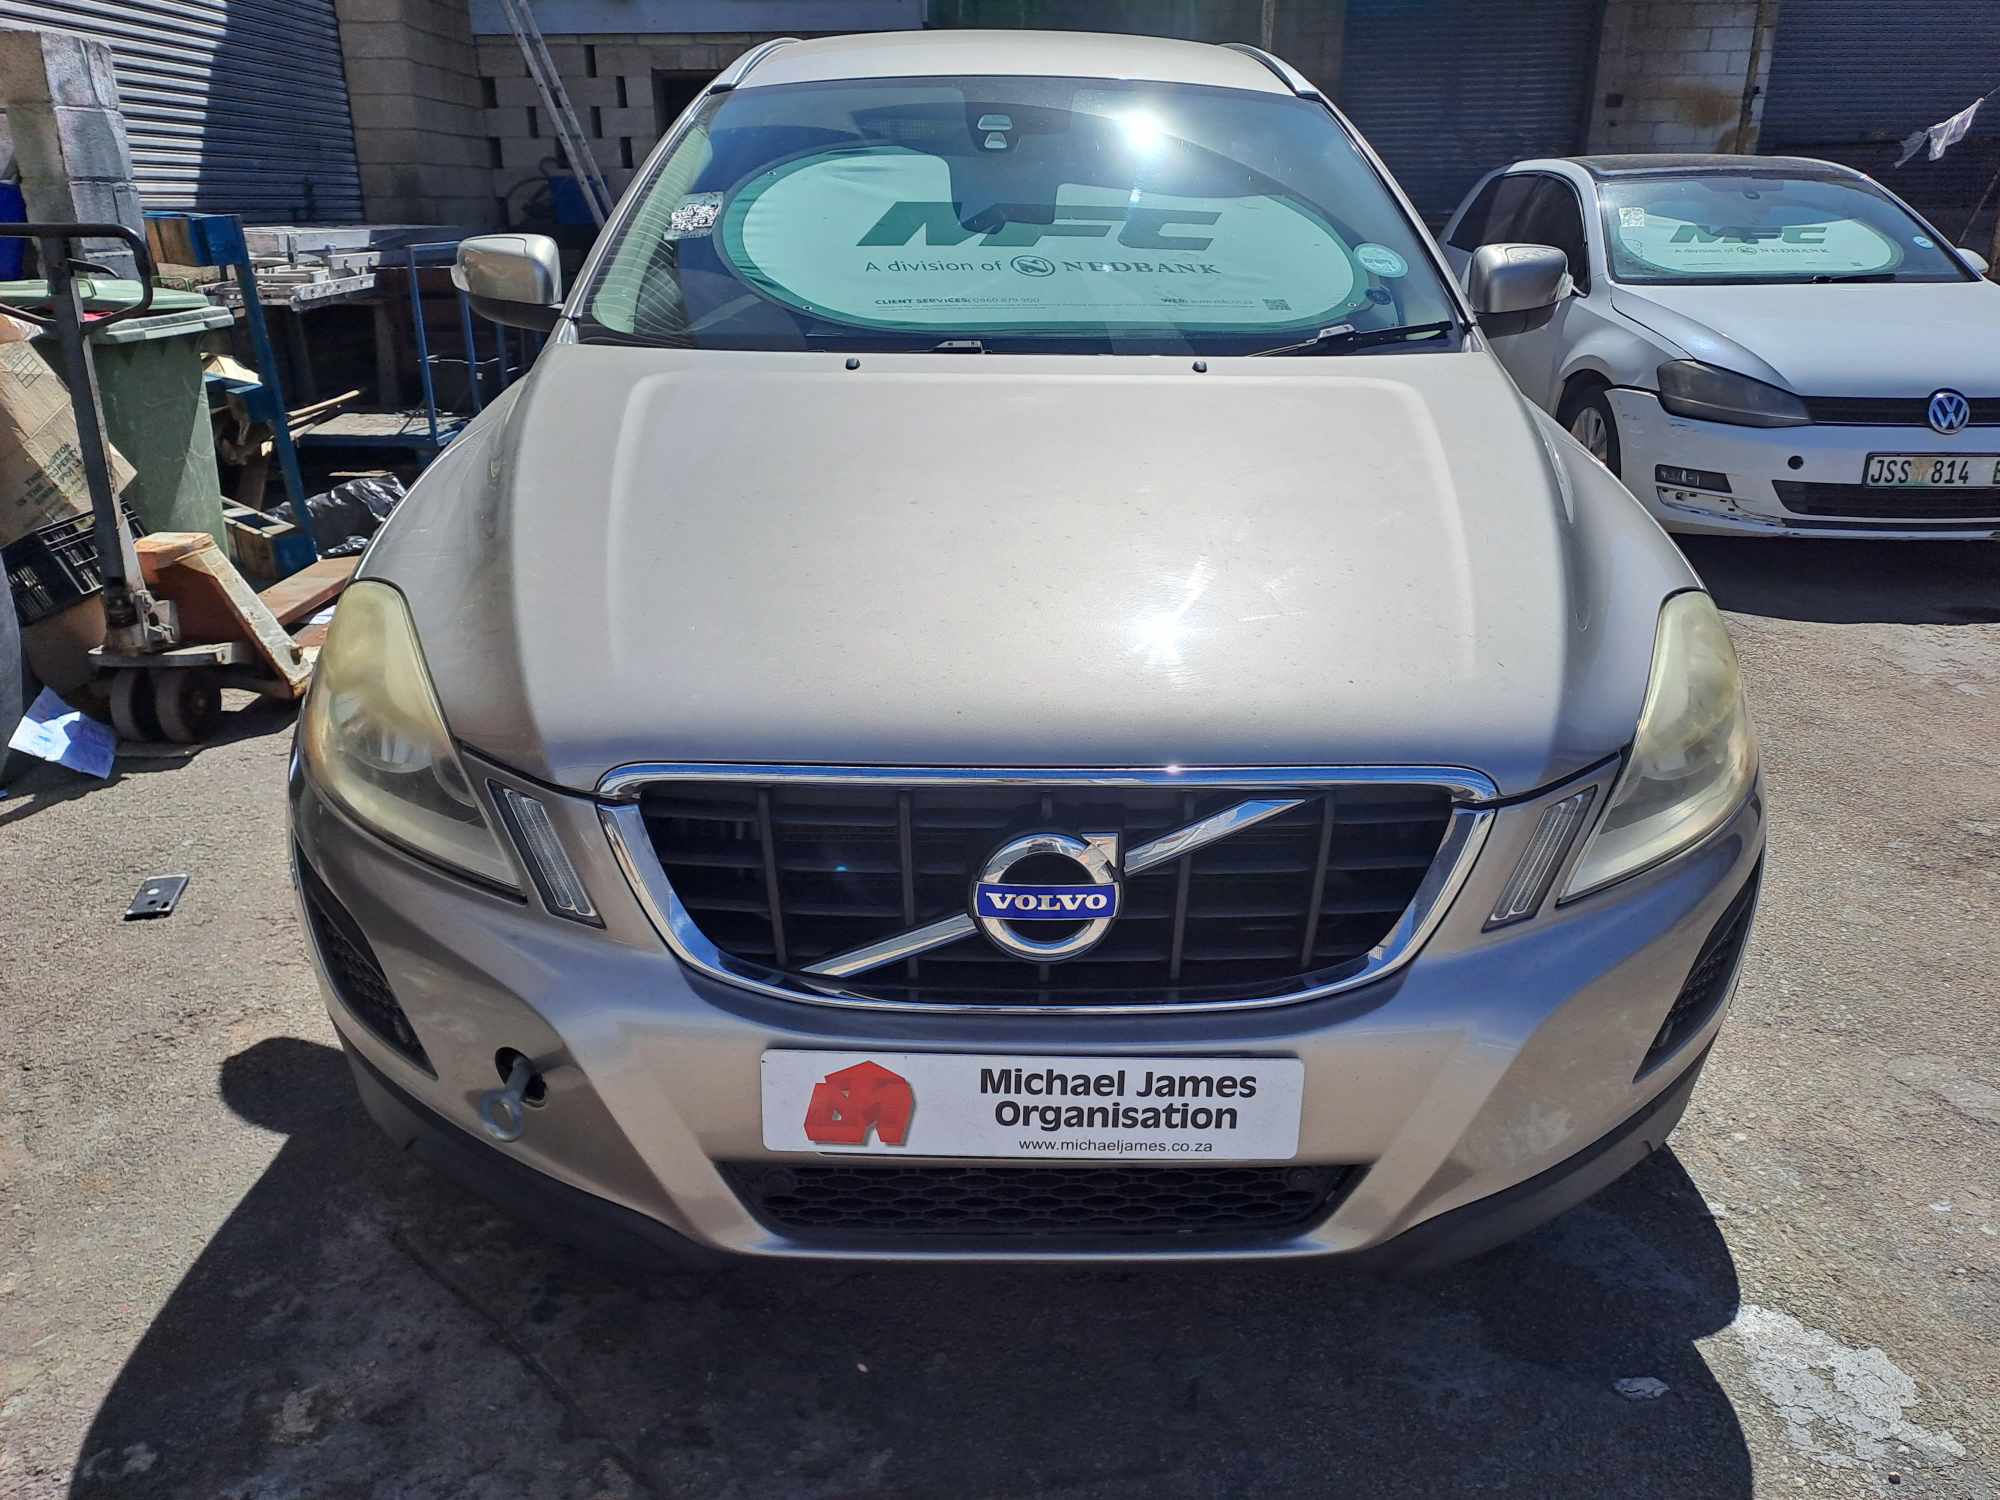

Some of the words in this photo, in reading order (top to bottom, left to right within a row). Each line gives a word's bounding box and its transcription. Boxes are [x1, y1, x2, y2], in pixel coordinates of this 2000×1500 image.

[856, 201, 1223, 251] MFC
[865, 261, 881, 272] A
[887, 260, 974, 273] division
[981, 260, 1003, 272] of
[1061, 261, 1223, 274] NEDBANK
[1870, 459, 1912, 484] JSS
[1930, 460, 1969, 485] 814
[986, 892, 1107, 911] VOLVO
[980, 1068, 1126, 1097] Michael
[1136, 1071, 1257, 1098] James
[995, 1100, 1238, 1132] Organisation
[1018, 1138, 1213, 1154] www.michaeljames.co.za
